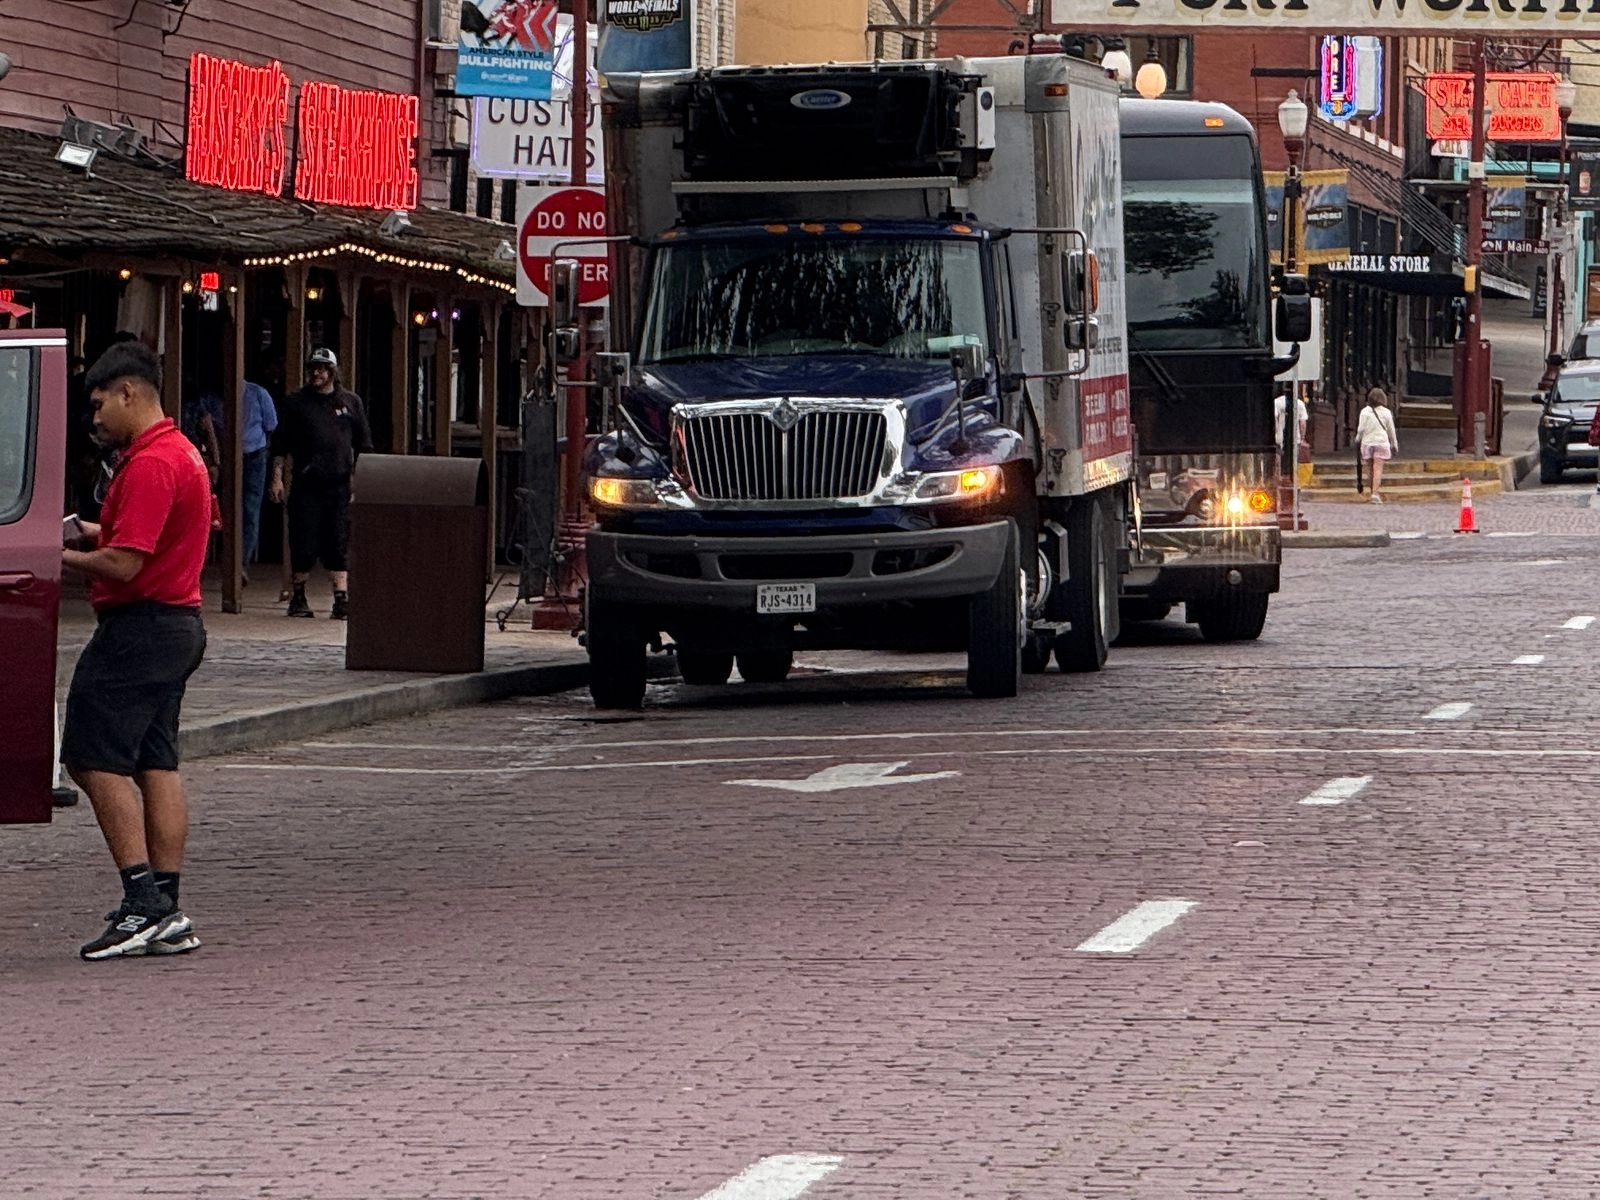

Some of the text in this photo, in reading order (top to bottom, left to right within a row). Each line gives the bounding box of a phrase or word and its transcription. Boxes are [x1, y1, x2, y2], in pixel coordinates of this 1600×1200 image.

[608, 0, 641, 14] WORLD
[469, 47, 544, 59] AMERICAN STYLE
[458, 54, 553, 71] BULLFIGHTING
[537, 211, 606, 230] DO NO
[1494, 240, 1533, 253] N Main
[1389, 255, 1431, 272] STORE
